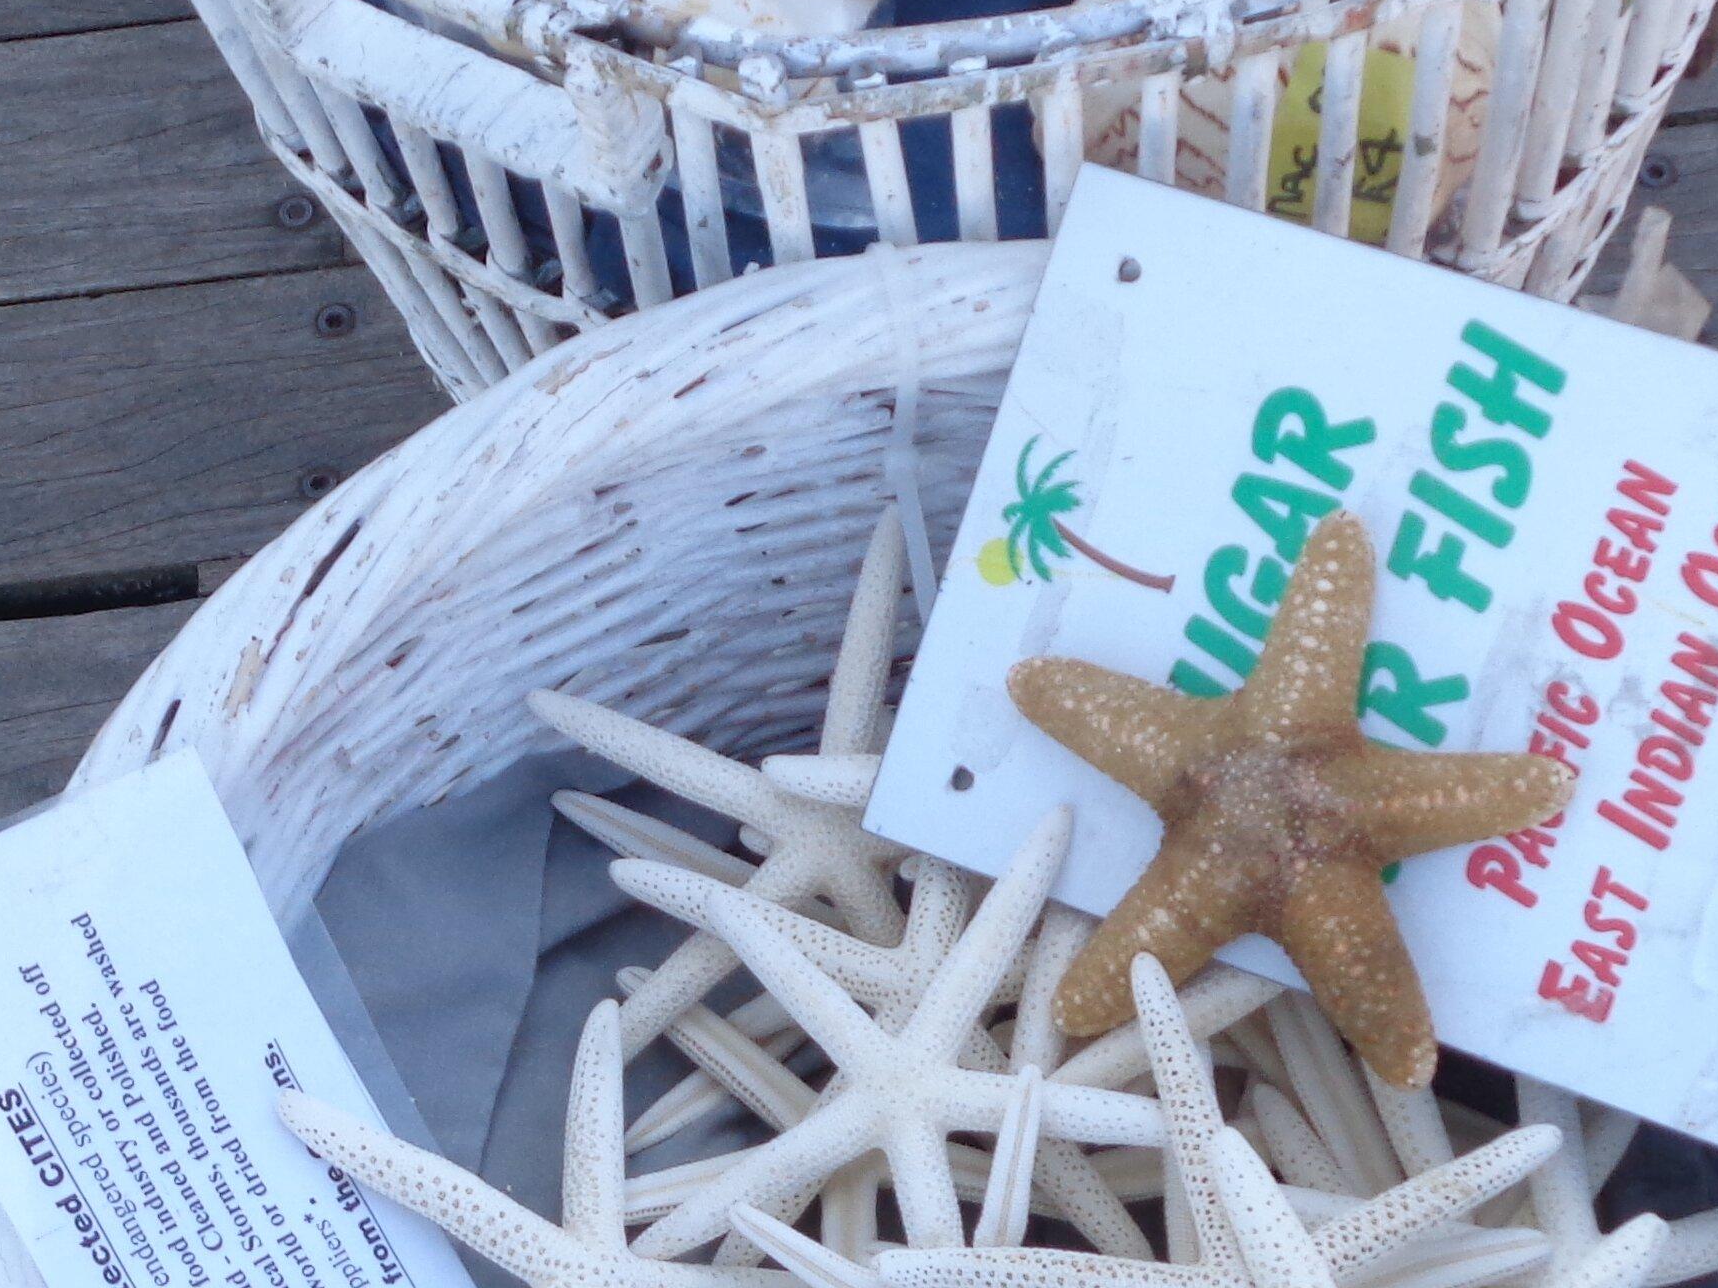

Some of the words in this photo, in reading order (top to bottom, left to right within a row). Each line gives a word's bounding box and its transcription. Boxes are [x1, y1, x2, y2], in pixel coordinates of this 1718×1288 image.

[1386, 321, 1567, 614] FISH
[1169, 386, 1377, 702] UGAR
[1464, 681, 1601, 908] PAFIC
[1551, 461, 1676, 662] OCEAN
[16, 961, 52, 997] off
[69, 910, 126, 1001] washed
[1537, 867, 1649, 1024] EAST
[38, 998, 105, 1103] collected
[118, 1001, 149, 1043] are
[137, 977, 180, 1033] food
[24, 1050, 94, 1149] species)
[80, 1001, 147, 1111] Polished.
[170, 1034, 200, 1074] the
[96, 1107, 122, 1133] or
[132, 1109, 173, 1157] and
[139, 1044, 211, 1163] thousands
[192, 1075, 234, 1136] from
[113, 1138, 180, 1237] industry
[158, 1158, 225, 1253] Cleaned
[206, 1161, 265, 1254] Storms,
[219, 1135, 269, 1198] dried
[320, 1161, 363, 1215] the
[77, 1150, 171, 1288] endangered
[165, 1234, 212, 1288] food
[260, 1203, 287, 1229] or
[356, 1215, 405, 1287] from
